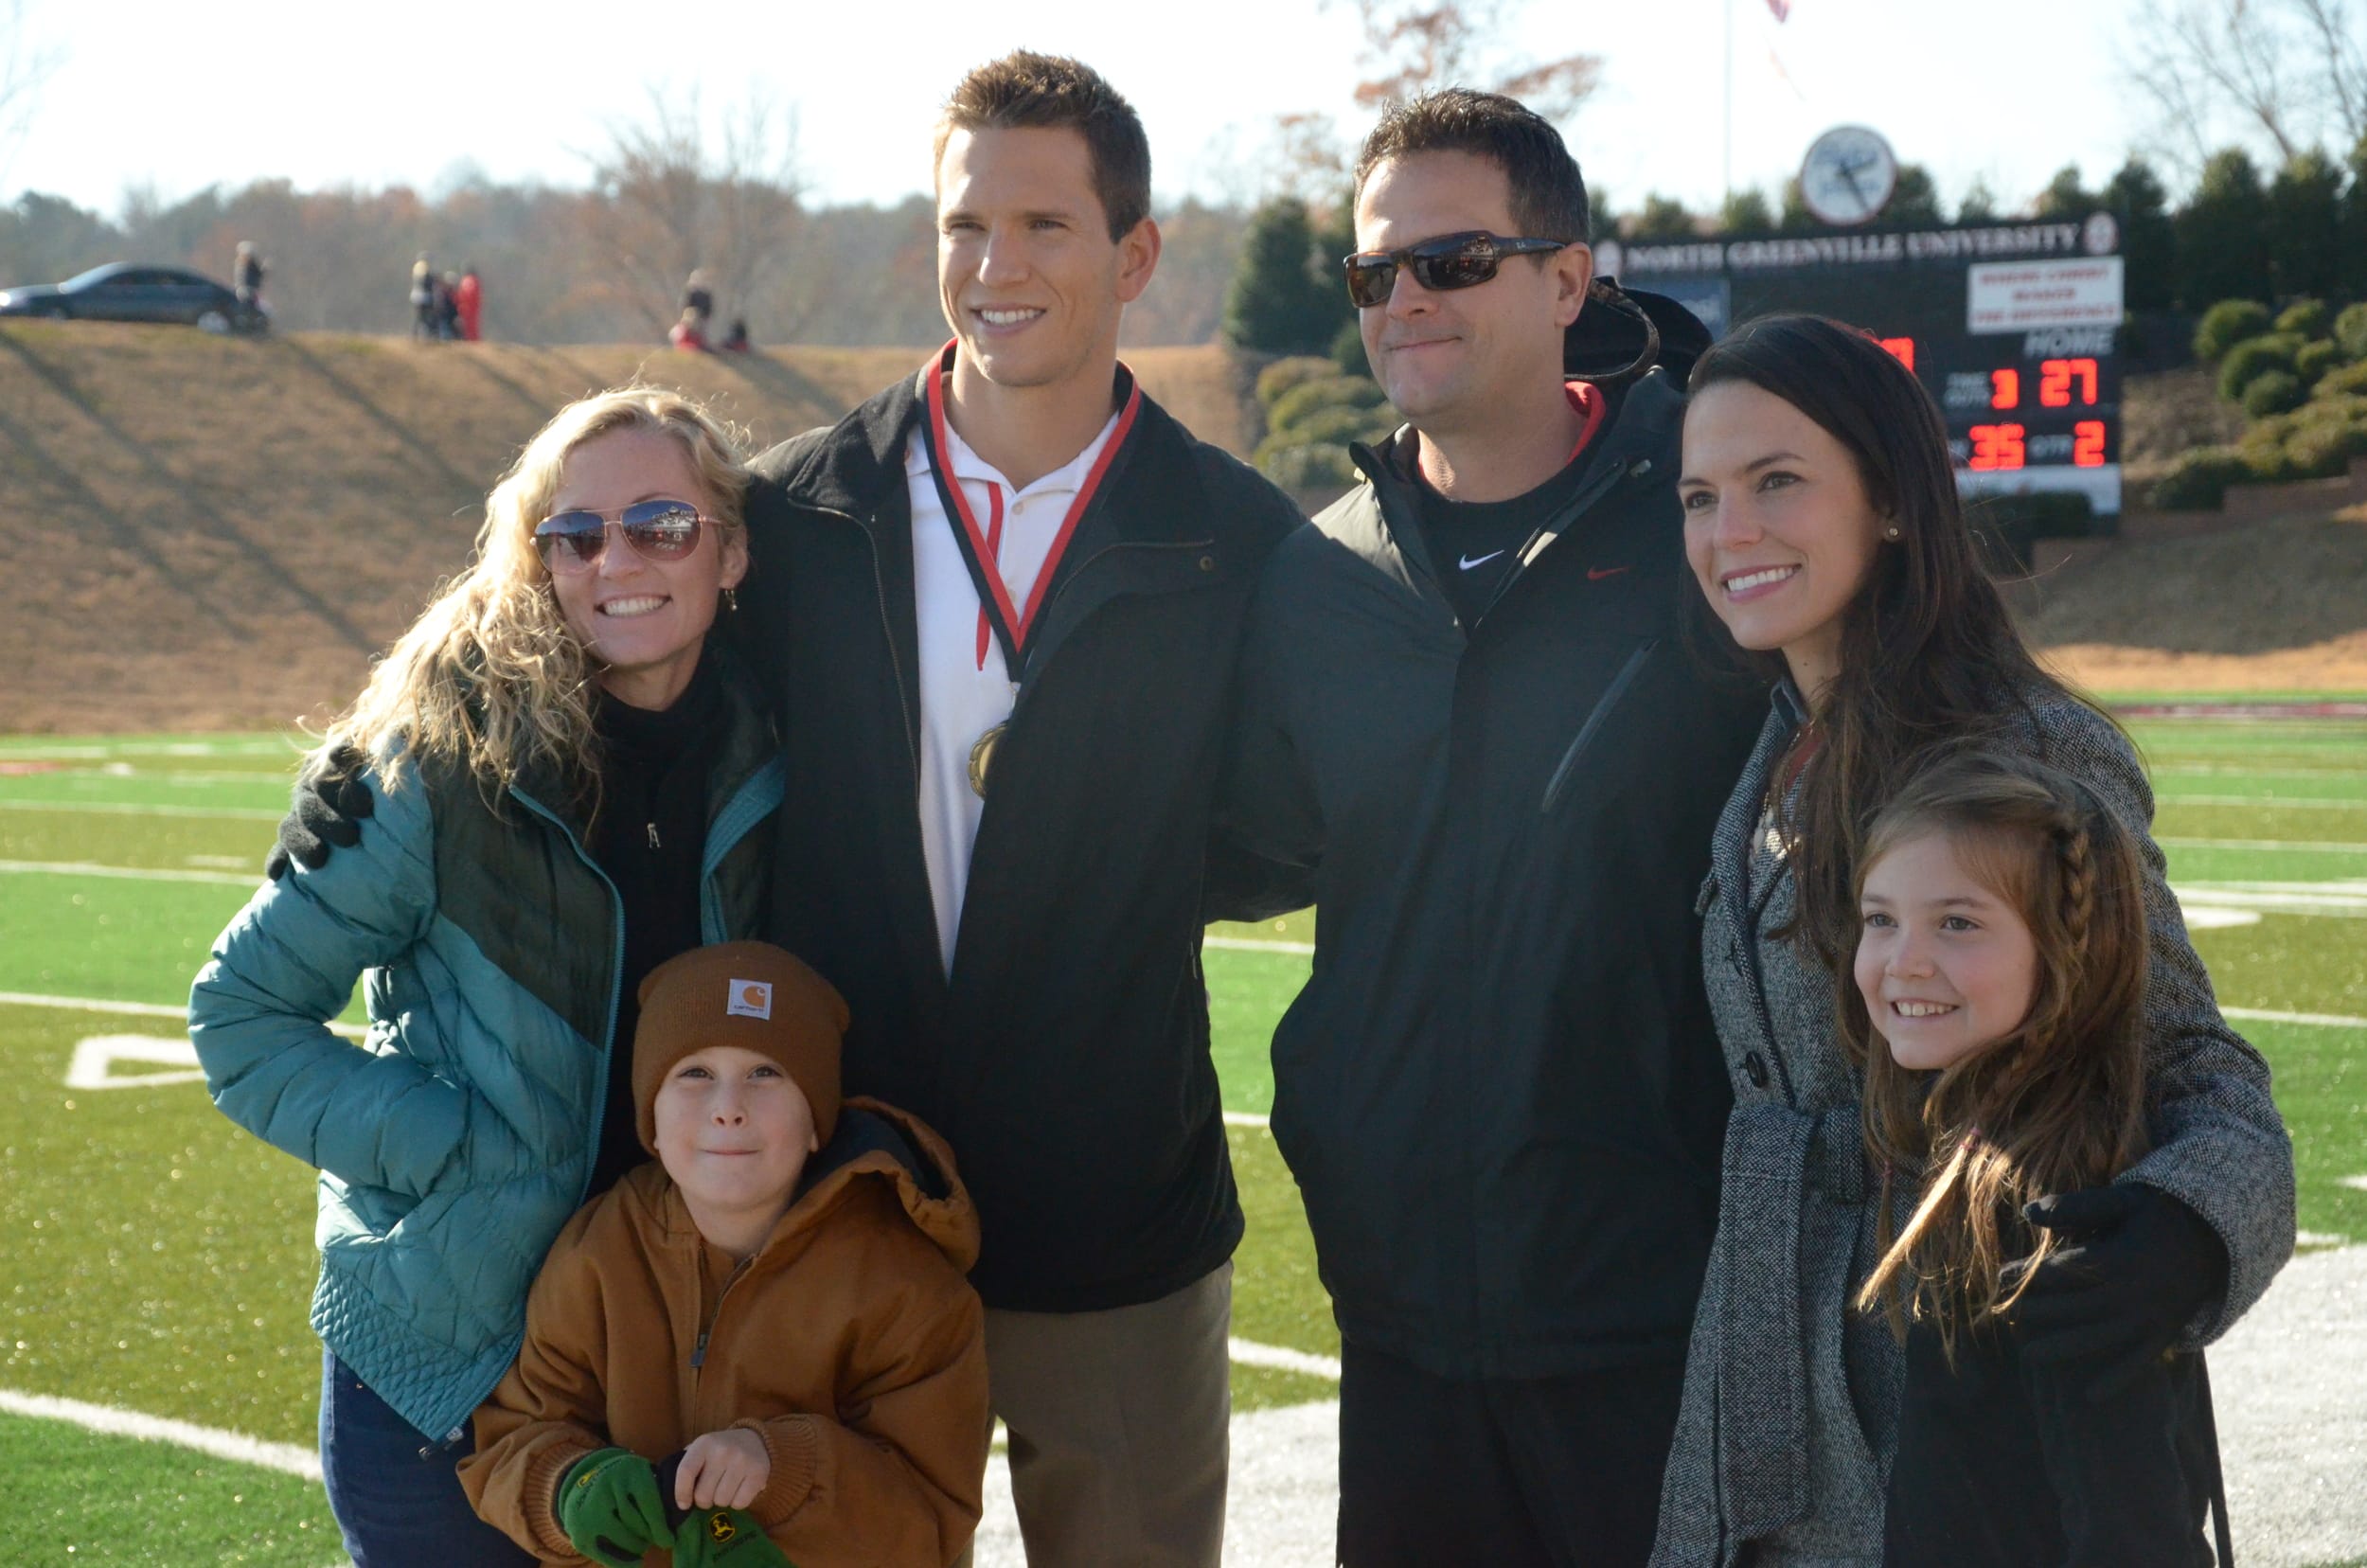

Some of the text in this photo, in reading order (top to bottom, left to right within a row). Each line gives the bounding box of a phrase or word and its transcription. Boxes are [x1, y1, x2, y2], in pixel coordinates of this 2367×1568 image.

[1626, 223, 2080, 272] NORTH GREENVILLE UNIVERSITY
[2022, 325, 2115, 357] HOME
[1991, 368, 2019, 409] 3
[2040, 358, 2098, 407] 27
[1969, 424, 2025, 471] 35
[2074, 420, 2105, 467] 2
